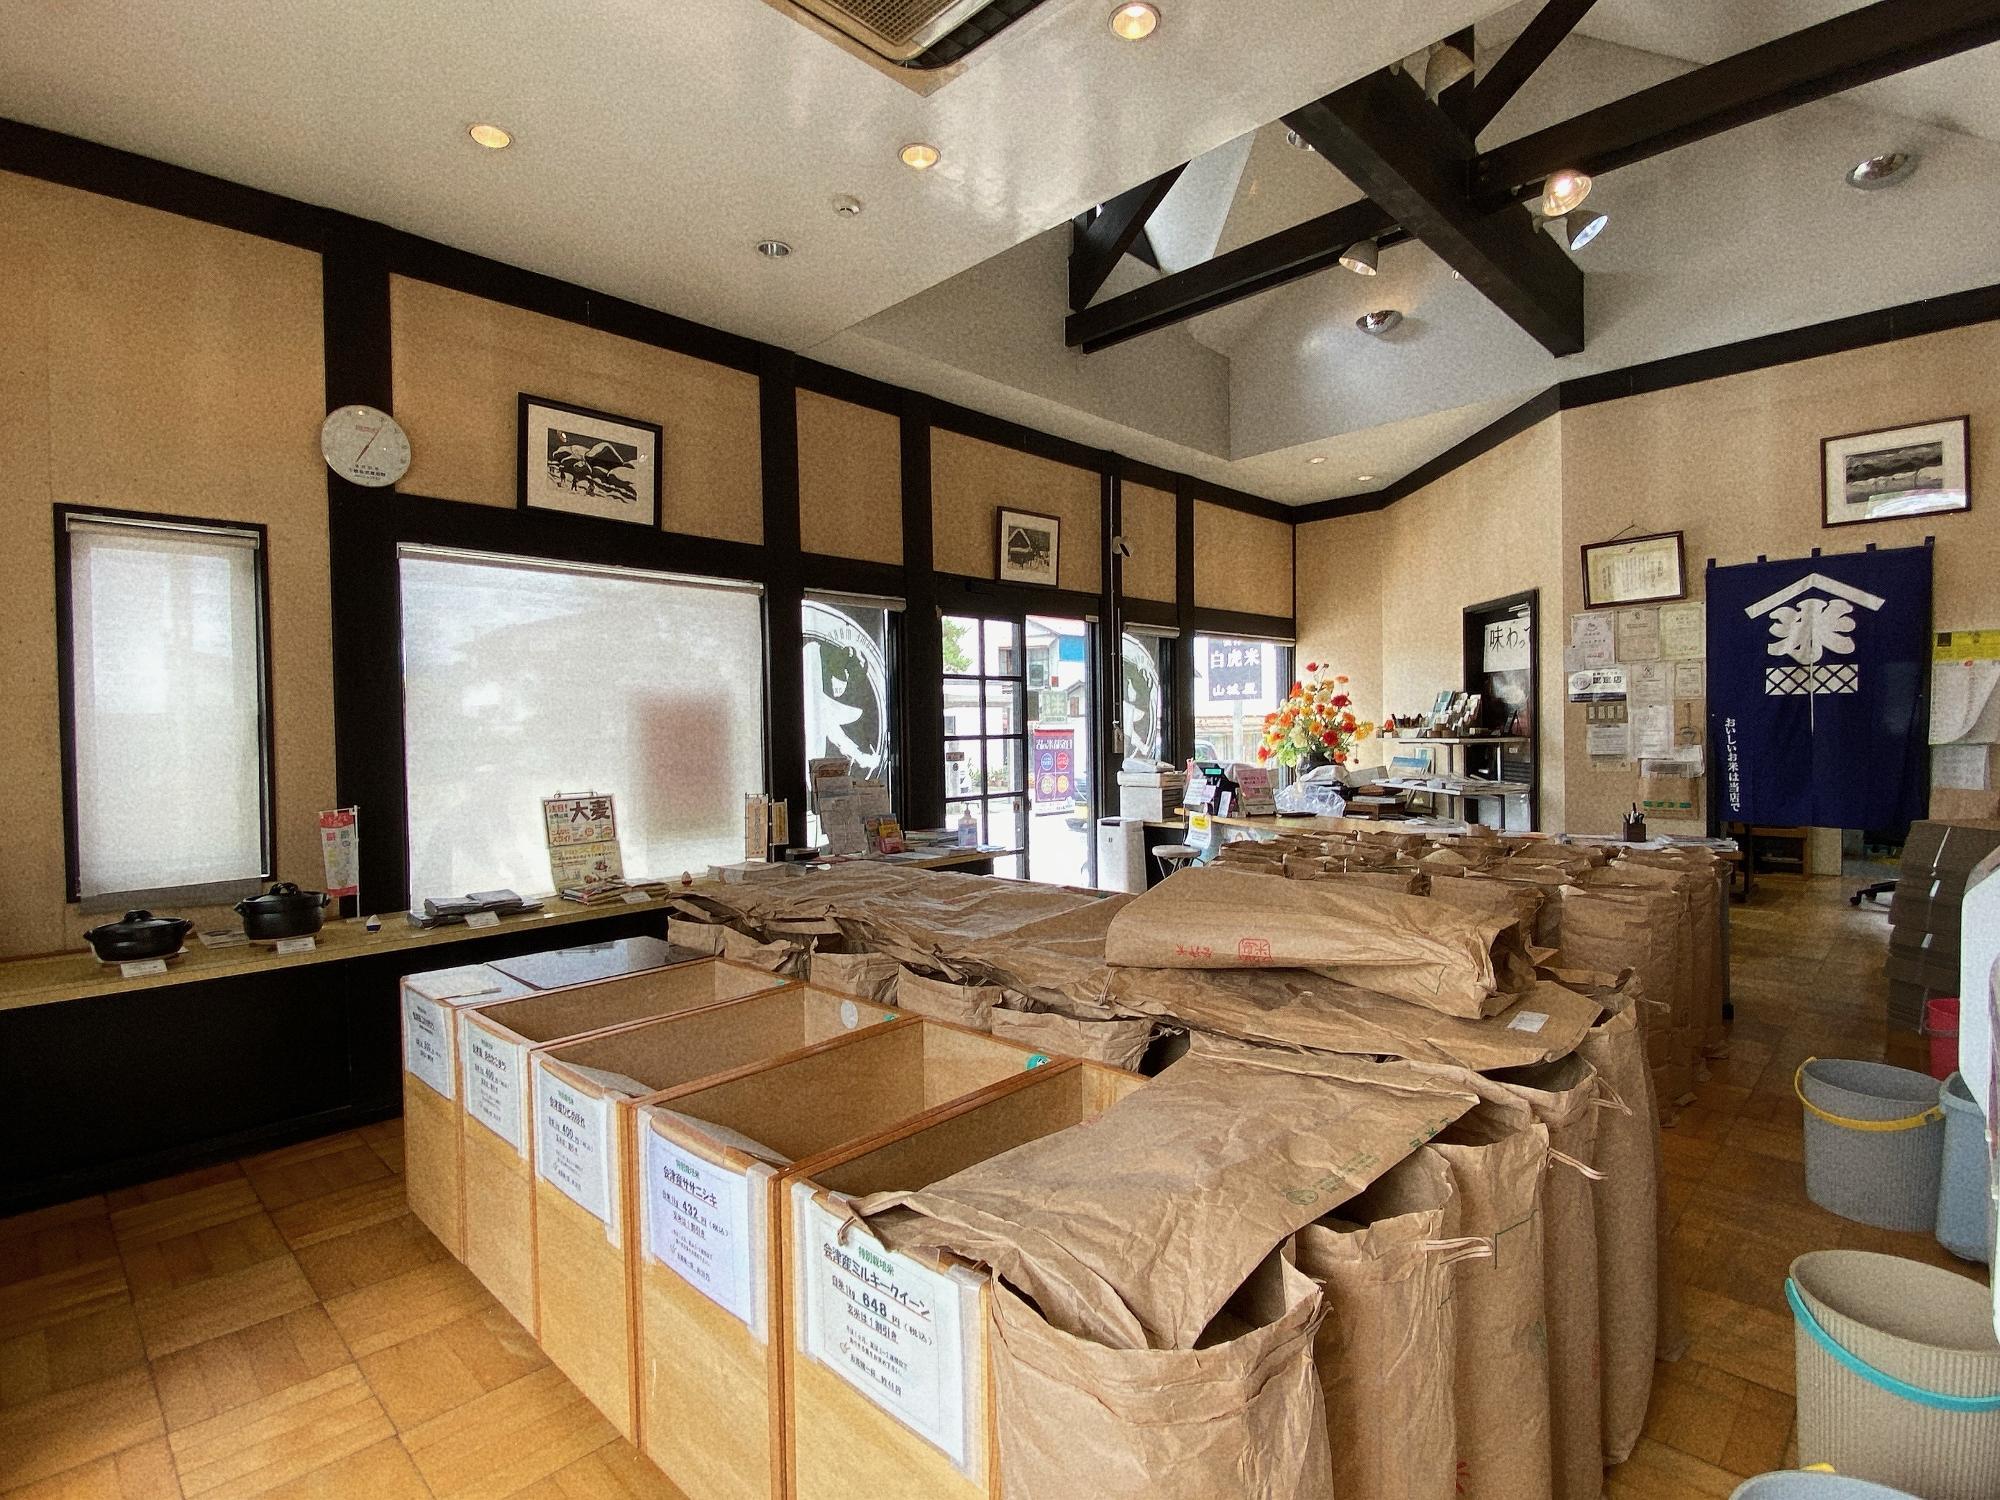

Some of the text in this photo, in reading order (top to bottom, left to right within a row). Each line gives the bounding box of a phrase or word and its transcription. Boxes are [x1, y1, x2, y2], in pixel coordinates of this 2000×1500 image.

[1725, 717, 1740, 812] おいしいお米は当店で
[570, 799, 611, 823] 大麦
[663, 1165, 718, 1207] 会津産ササニシキ
[682, 1200, 698, 1218] 432
[824, 1242, 931, 1316] 会津産ミルキークイーン
[858, 1245, 895, 1277] 特別栽培米
[831, 1274, 856, 1301] 白米1kg
[862, 1291, 888, 1318] 648
